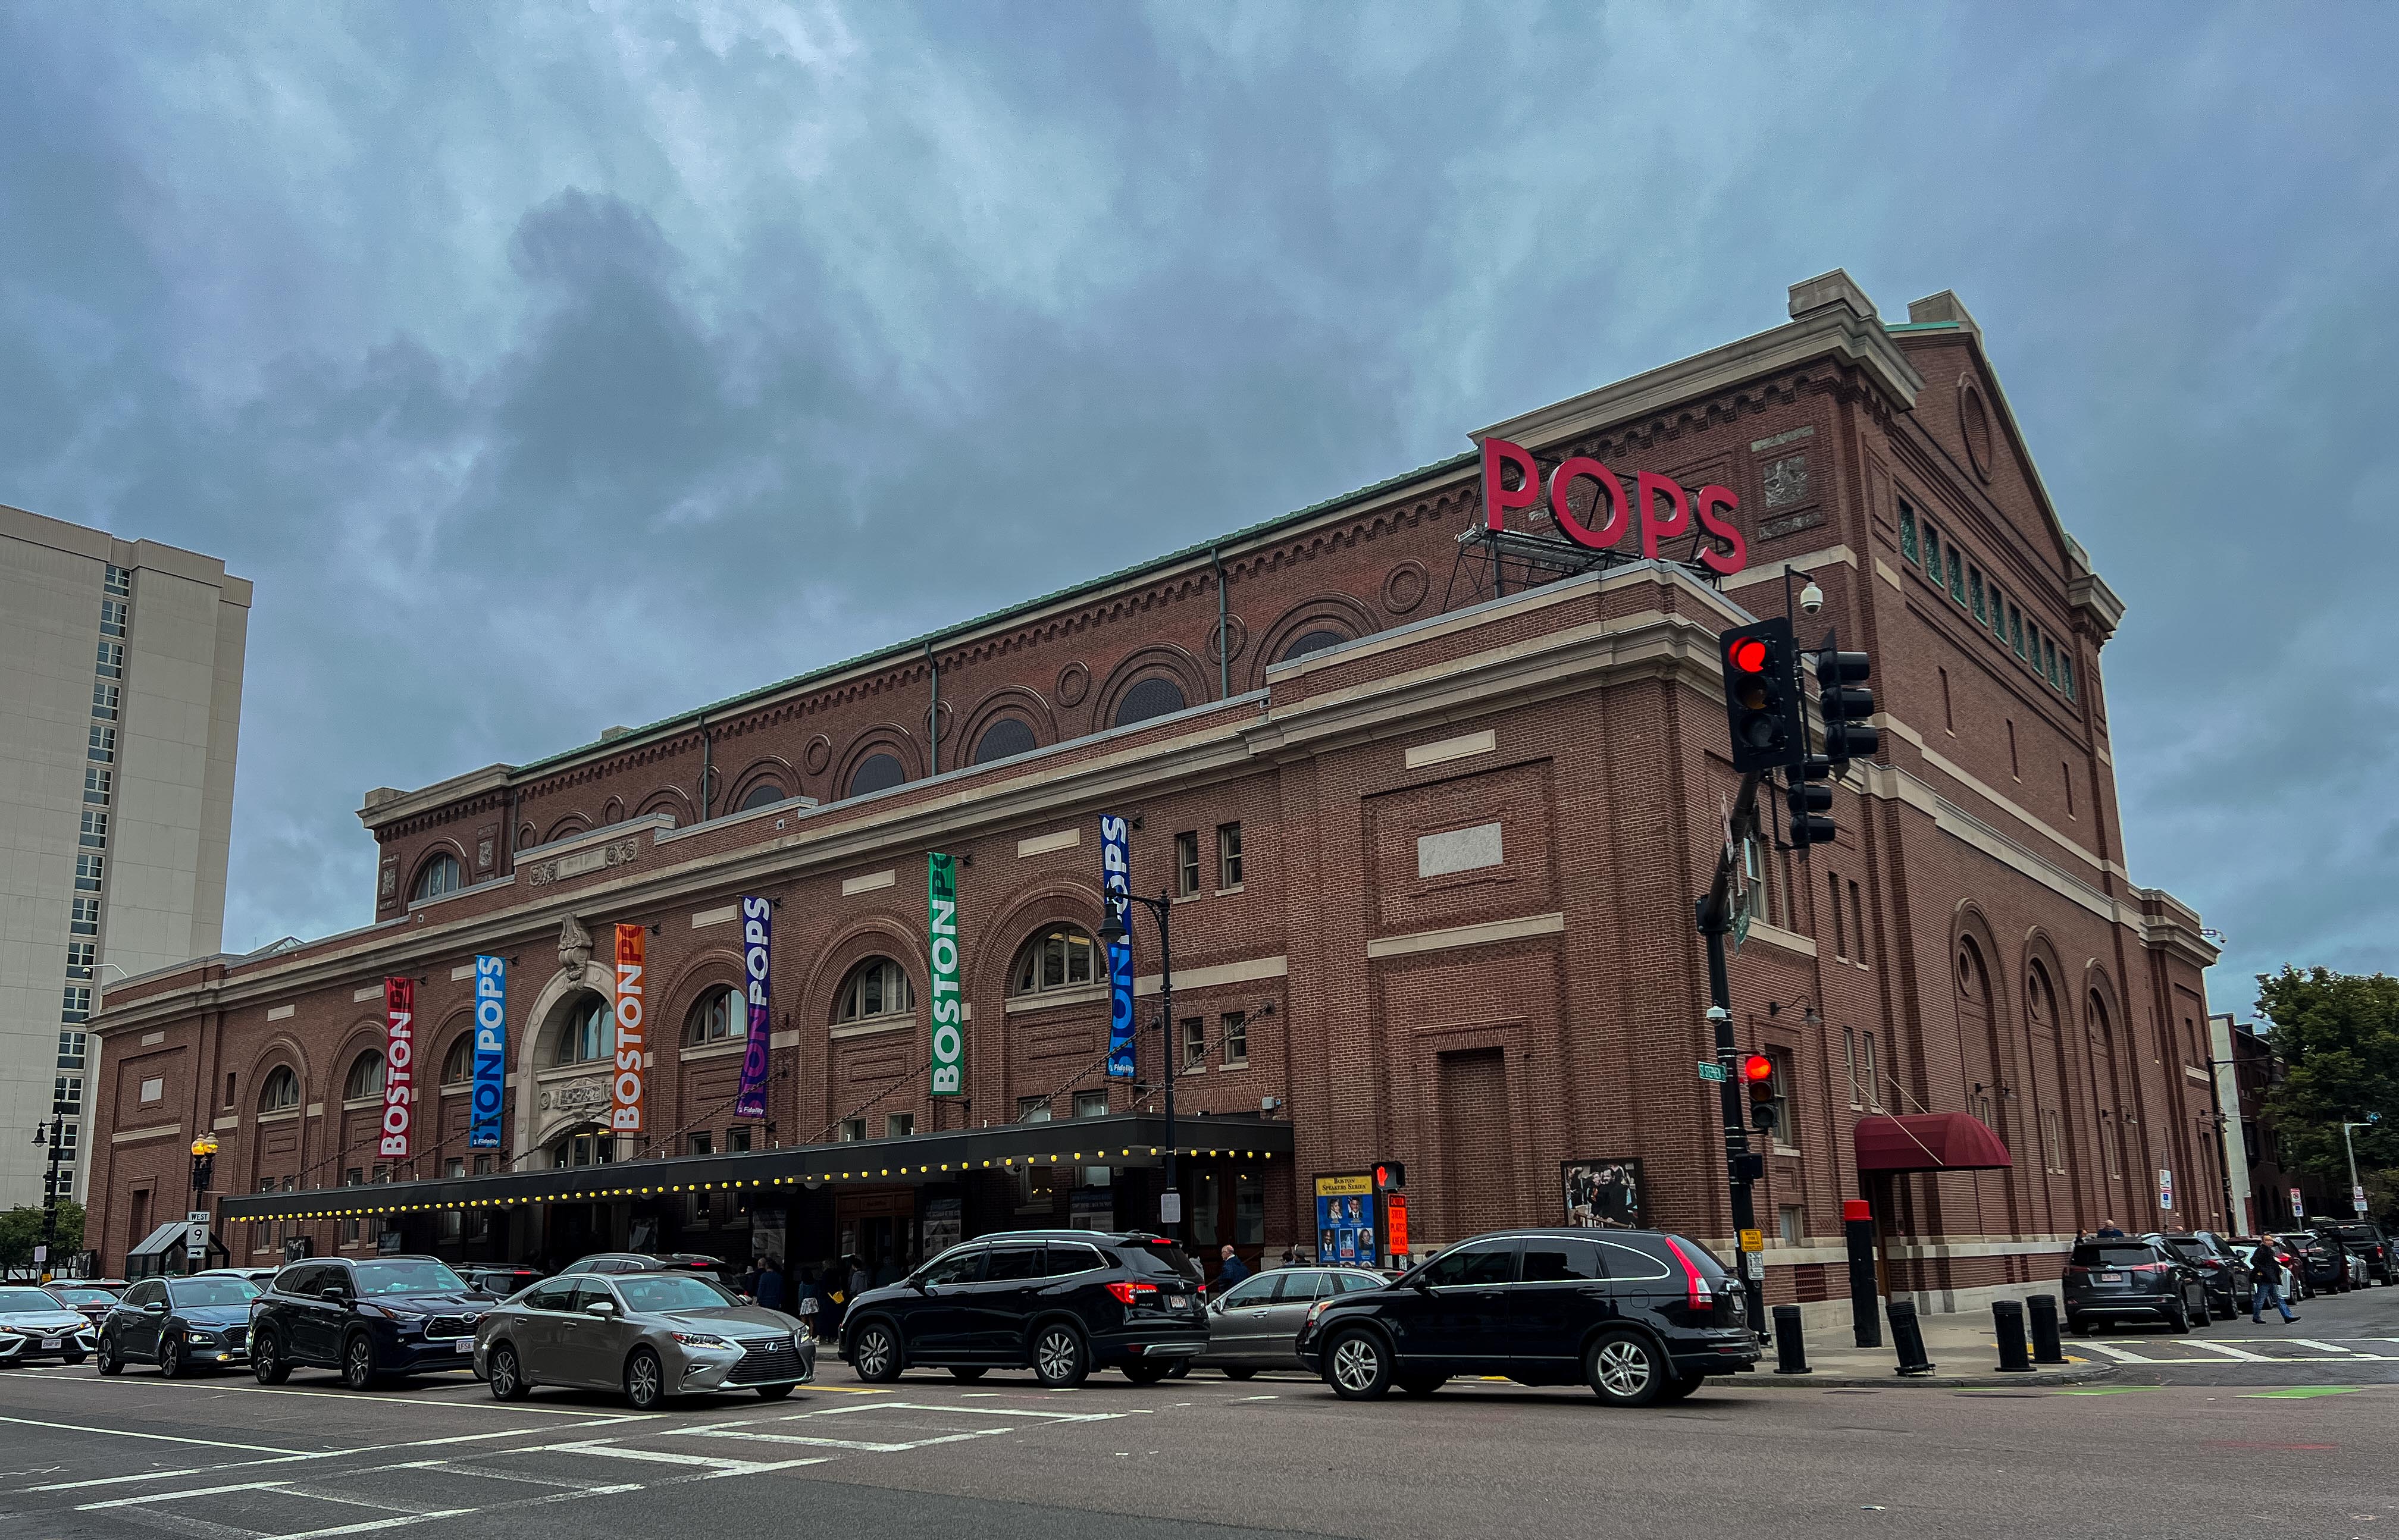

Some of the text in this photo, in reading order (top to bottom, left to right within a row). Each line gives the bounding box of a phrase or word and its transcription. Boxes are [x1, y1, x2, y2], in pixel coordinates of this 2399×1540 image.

[1480, 437, 1747, 575] POPS
[1103, 816, 1130, 945] OPS
[744, 898, 770, 1006] POPS
[932, 899, 960, 1092] BOSTON
[477, 956, 503, 1051] POPS
[613, 964, 643, 1129] BOSTON
[381, 1011, 412, 1155] BOSTON
[743, 1106, 764, 1115] Fidelity
[1114, 1064, 1135, 1073] Fidelity
[194, 1229, 202, 1241] 9
[1391, 1209, 1404, 1219] STEEL
[1391, 1222, 1405, 1232] PLATES
[1392, 1237, 1405, 1246] AHEAD
